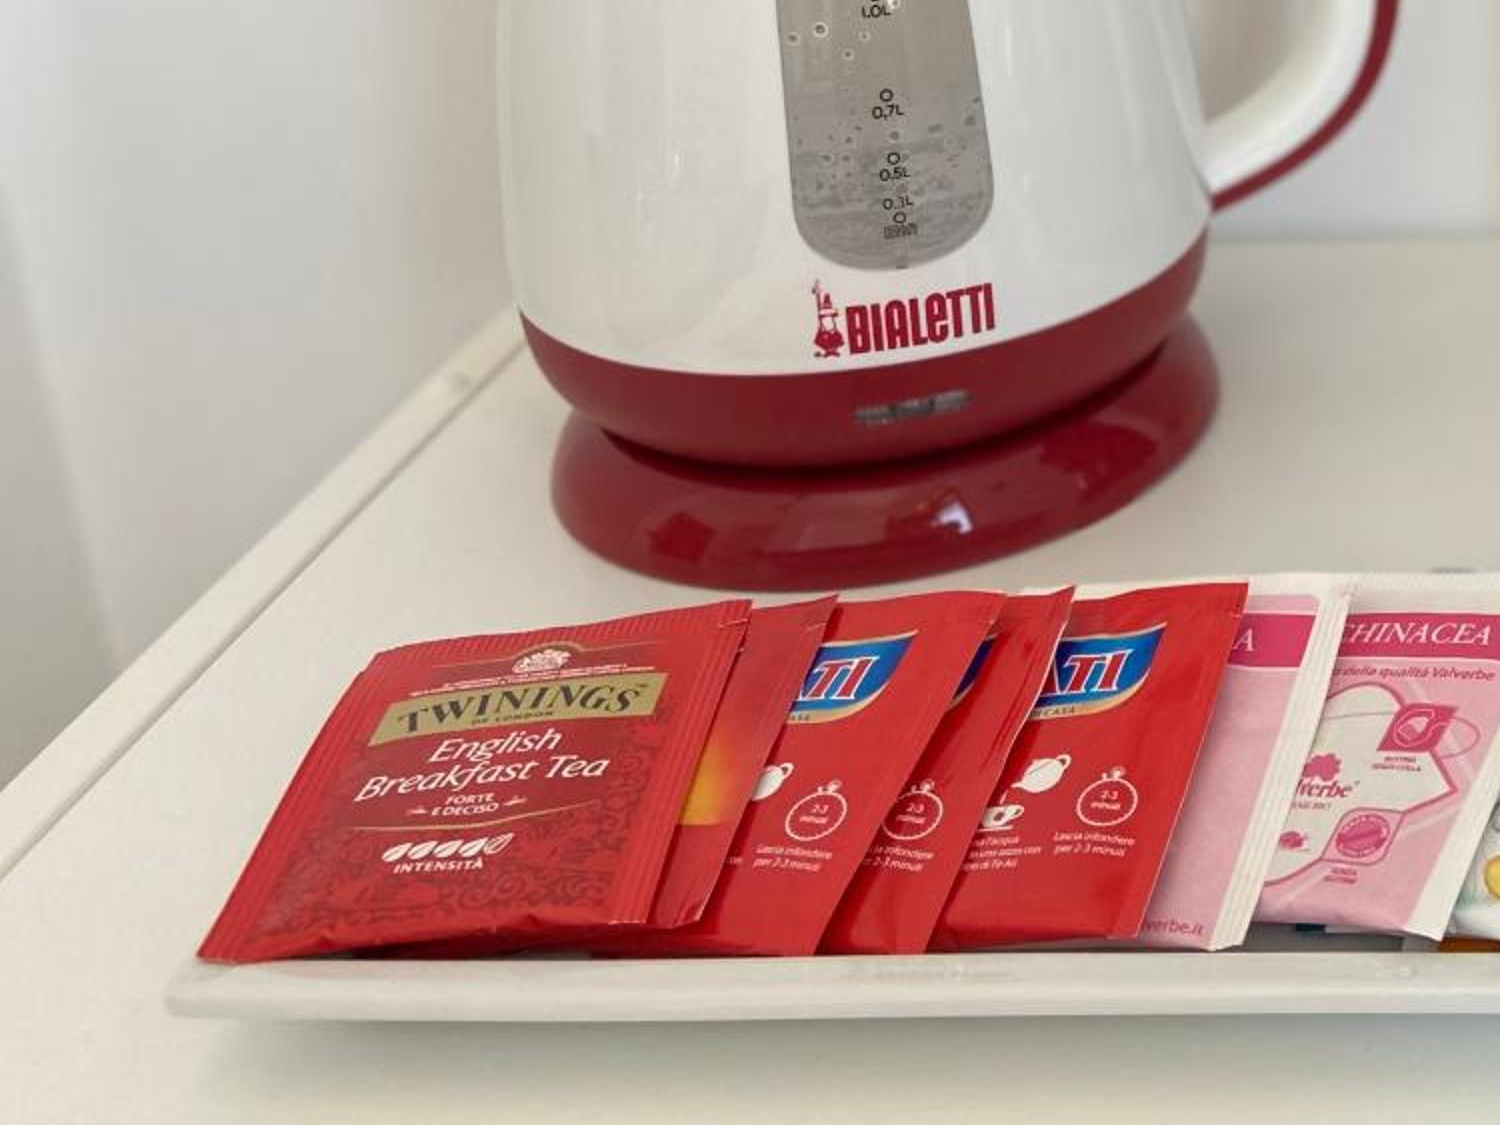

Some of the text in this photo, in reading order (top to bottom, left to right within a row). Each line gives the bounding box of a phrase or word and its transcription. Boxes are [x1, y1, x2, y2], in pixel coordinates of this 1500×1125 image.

[1345, 621, 1493, 646] HINACEA
[796, 655, 881, 701] TI
[400, 682, 641, 733] TWININGS
[428, 727, 563, 763] English
[353, 754, 611, 803] Breakfast Tea
[393, 855, 484, 874] INTENSITÀ
